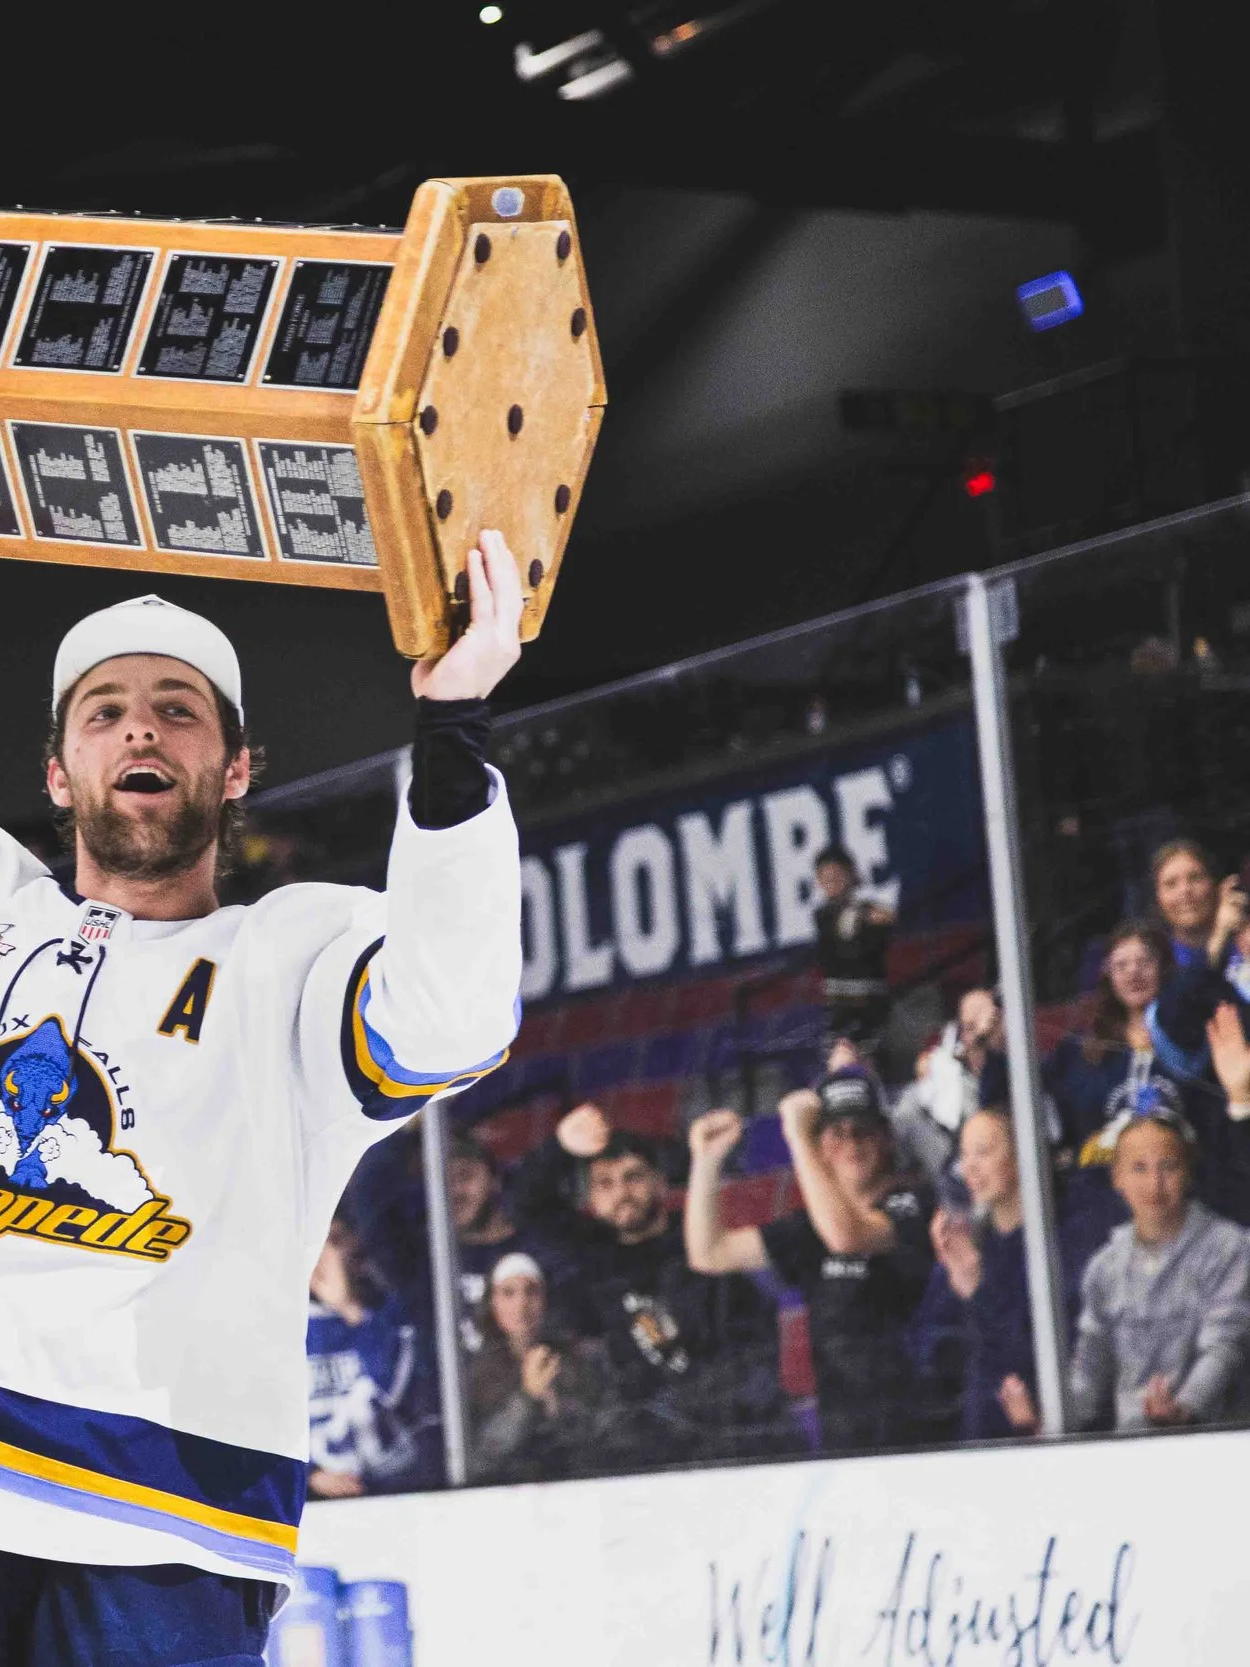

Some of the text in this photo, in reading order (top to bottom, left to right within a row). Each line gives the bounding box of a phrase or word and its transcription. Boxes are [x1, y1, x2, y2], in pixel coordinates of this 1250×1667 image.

[85, 918, 111, 929] USHL
[156, 956, 217, 1045] A
[77, 1035, 136, 1131] FALLS
[707, 1528, 1142, 1667] Well Adjusted
